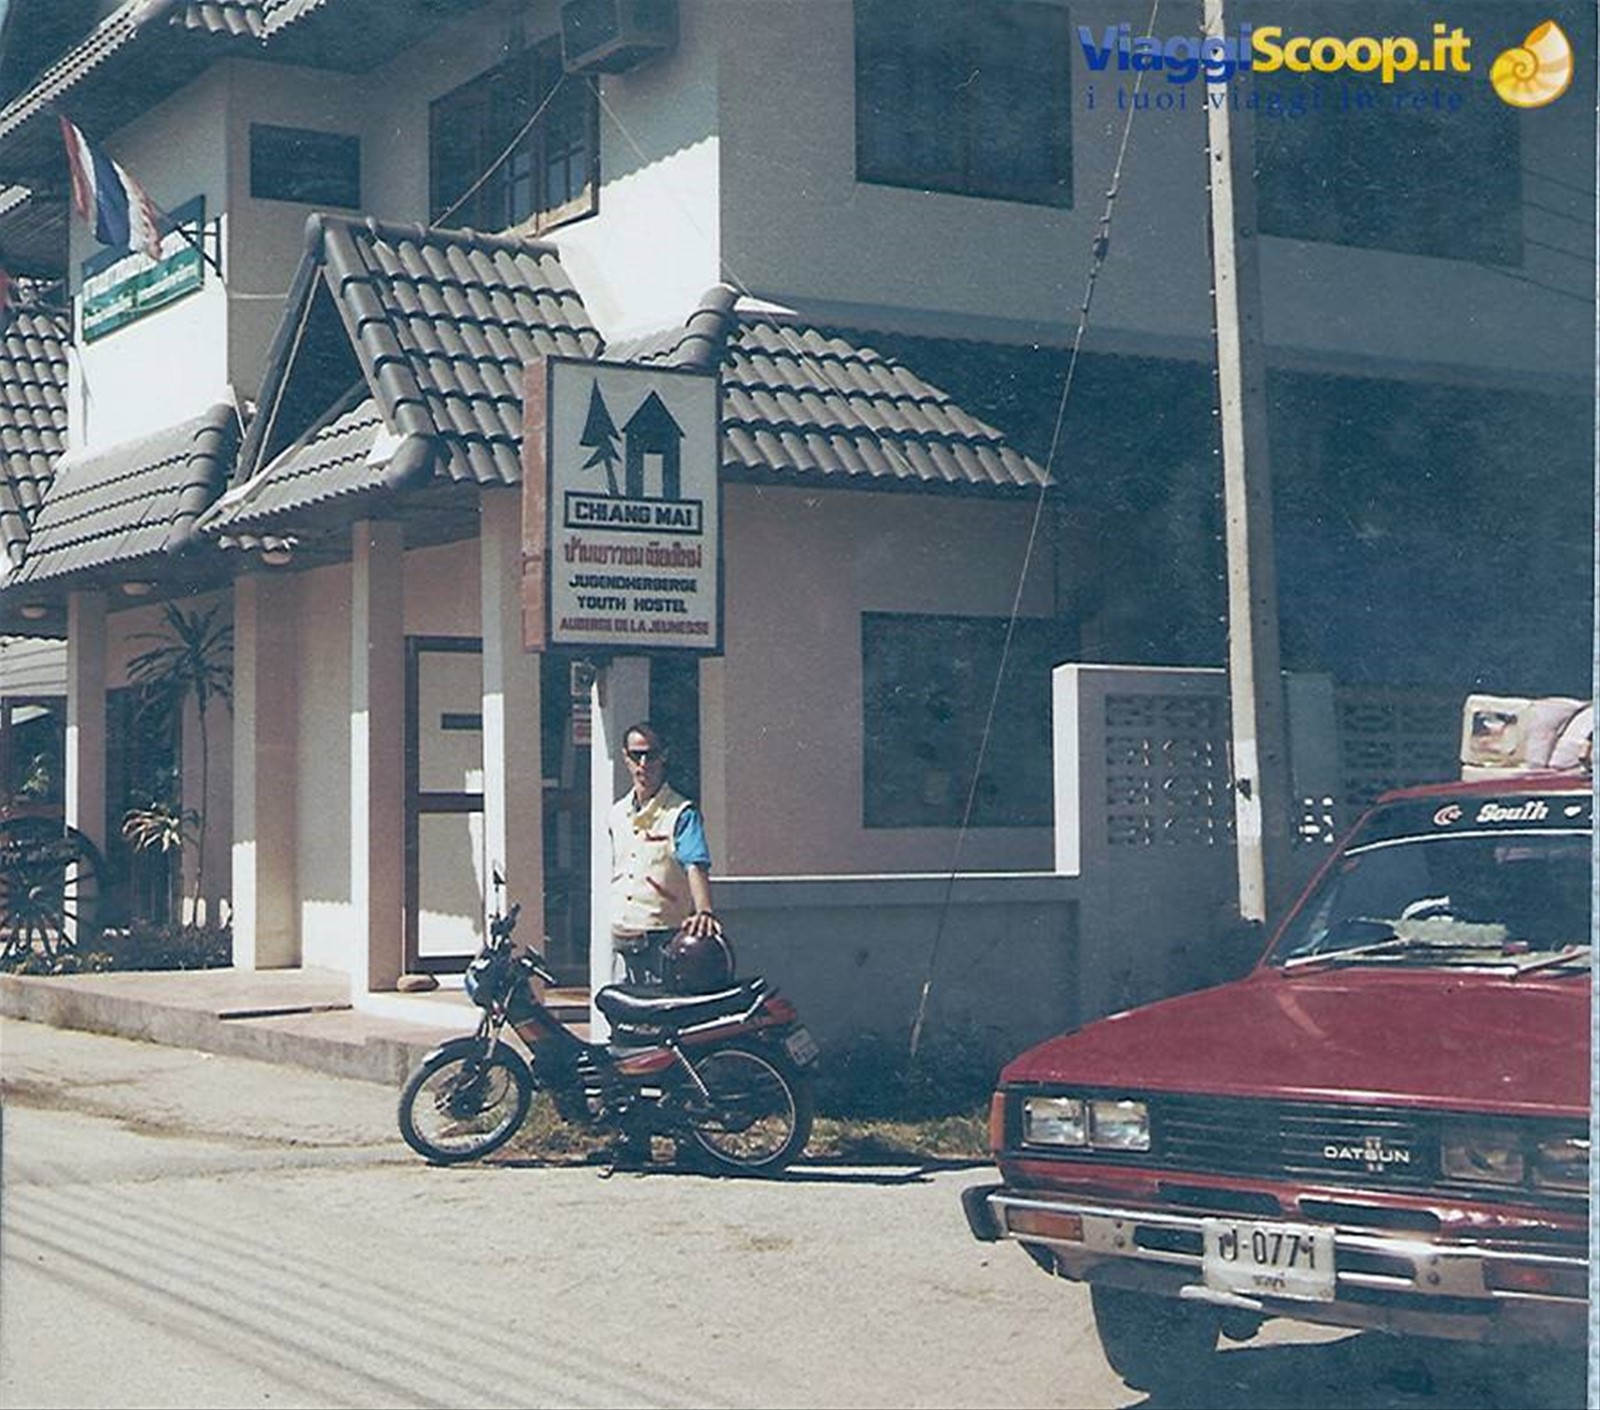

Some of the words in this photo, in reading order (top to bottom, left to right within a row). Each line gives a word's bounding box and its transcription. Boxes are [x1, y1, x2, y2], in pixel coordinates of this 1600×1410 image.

[575, 501, 651, 524] CHIANG
[655, 506, 692, 526] MAI
[569, 574, 697, 593] JUGENDHERBERGE
[577, 596, 626, 610] YOUTH
[633, 597, 688, 613] HOSTEL
[630, 619, 646, 632] LA
[1476, 801, 1549, 823] South
[1323, 1144, 1411, 1163] DATSUN
